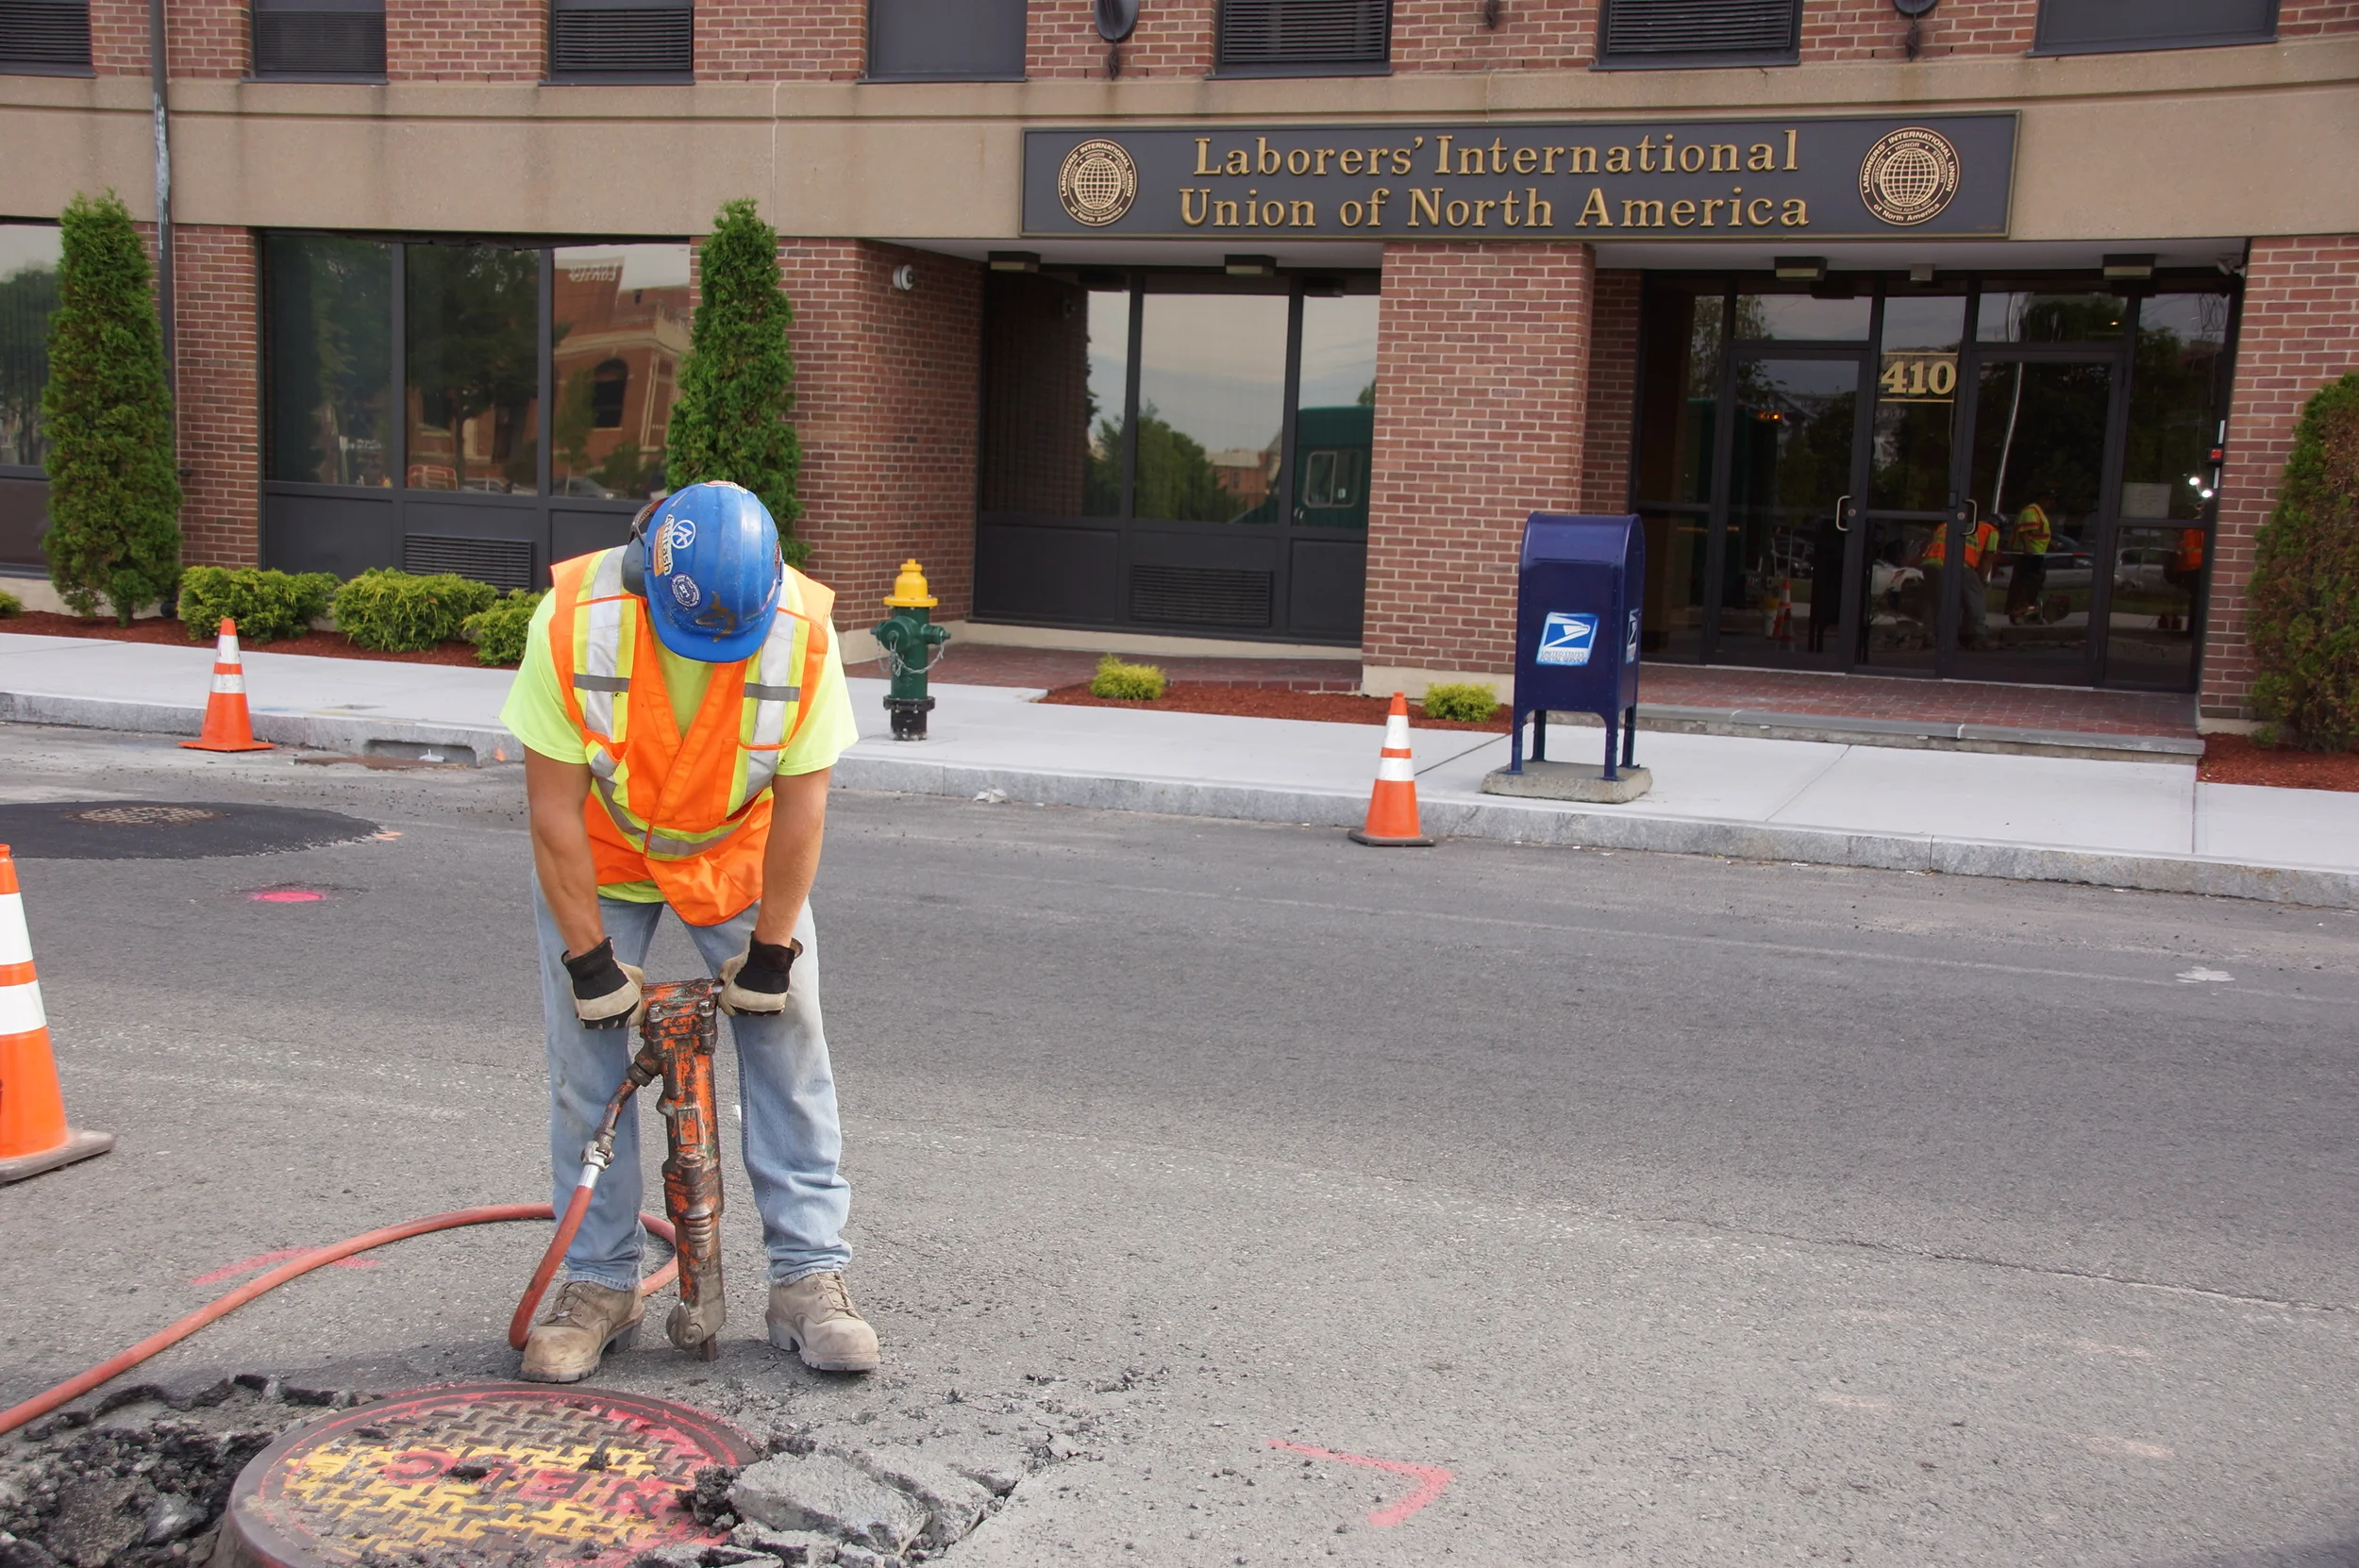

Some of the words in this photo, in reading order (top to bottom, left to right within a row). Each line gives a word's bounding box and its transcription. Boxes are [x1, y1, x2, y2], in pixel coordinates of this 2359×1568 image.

[1193, 136, 1424, 176] Laborers'
[1433, 129, 1799, 176] International
[1887, 131, 1951, 160] INTERNATIONAL
[1946, 161, 1956, 192] UNION
[1895, 142, 1920, 151] HONOR
[1079, 142, 1130, 169] INTERNATIONAL
[1126, 170, 1134, 197] UNION
[1096, 207, 1123, 223] America
[1179, 188, 1316, 227] Union
[1339, 188, 1390, 227] of
[1407, 188, 1554, 227] North
[1575, 187, 1810, 227] America
[1873, 204, 1882, 212] of
[1882, 209, 1904, 222] North
[1906, 203, 1940, 222] America
[1880, 360, 1957, 394] 410
[662, 515, 673, 574] Attitash
